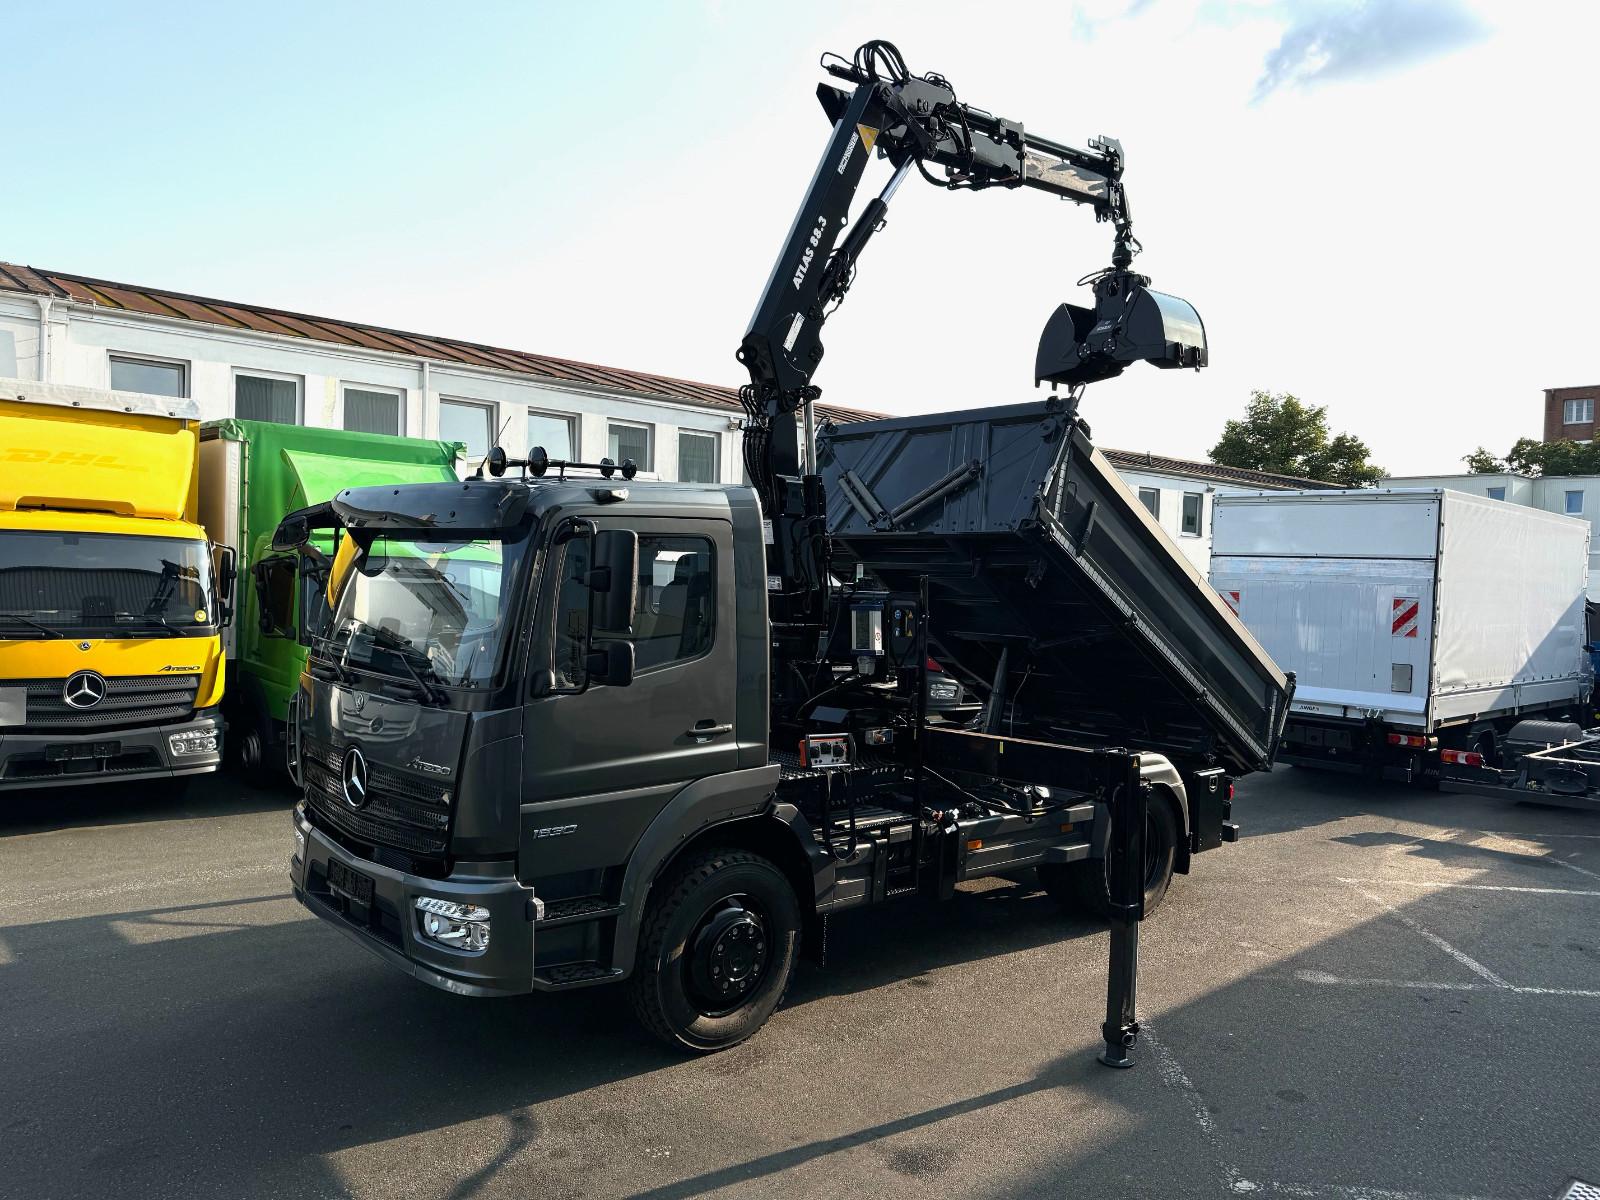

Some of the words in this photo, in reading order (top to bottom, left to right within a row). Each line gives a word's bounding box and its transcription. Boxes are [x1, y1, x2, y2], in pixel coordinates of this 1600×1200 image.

[793, 246, 814, 290] ATLAS
[810, 215, 827, 248] 88.3
[5, 448, 132, 470] DHL
